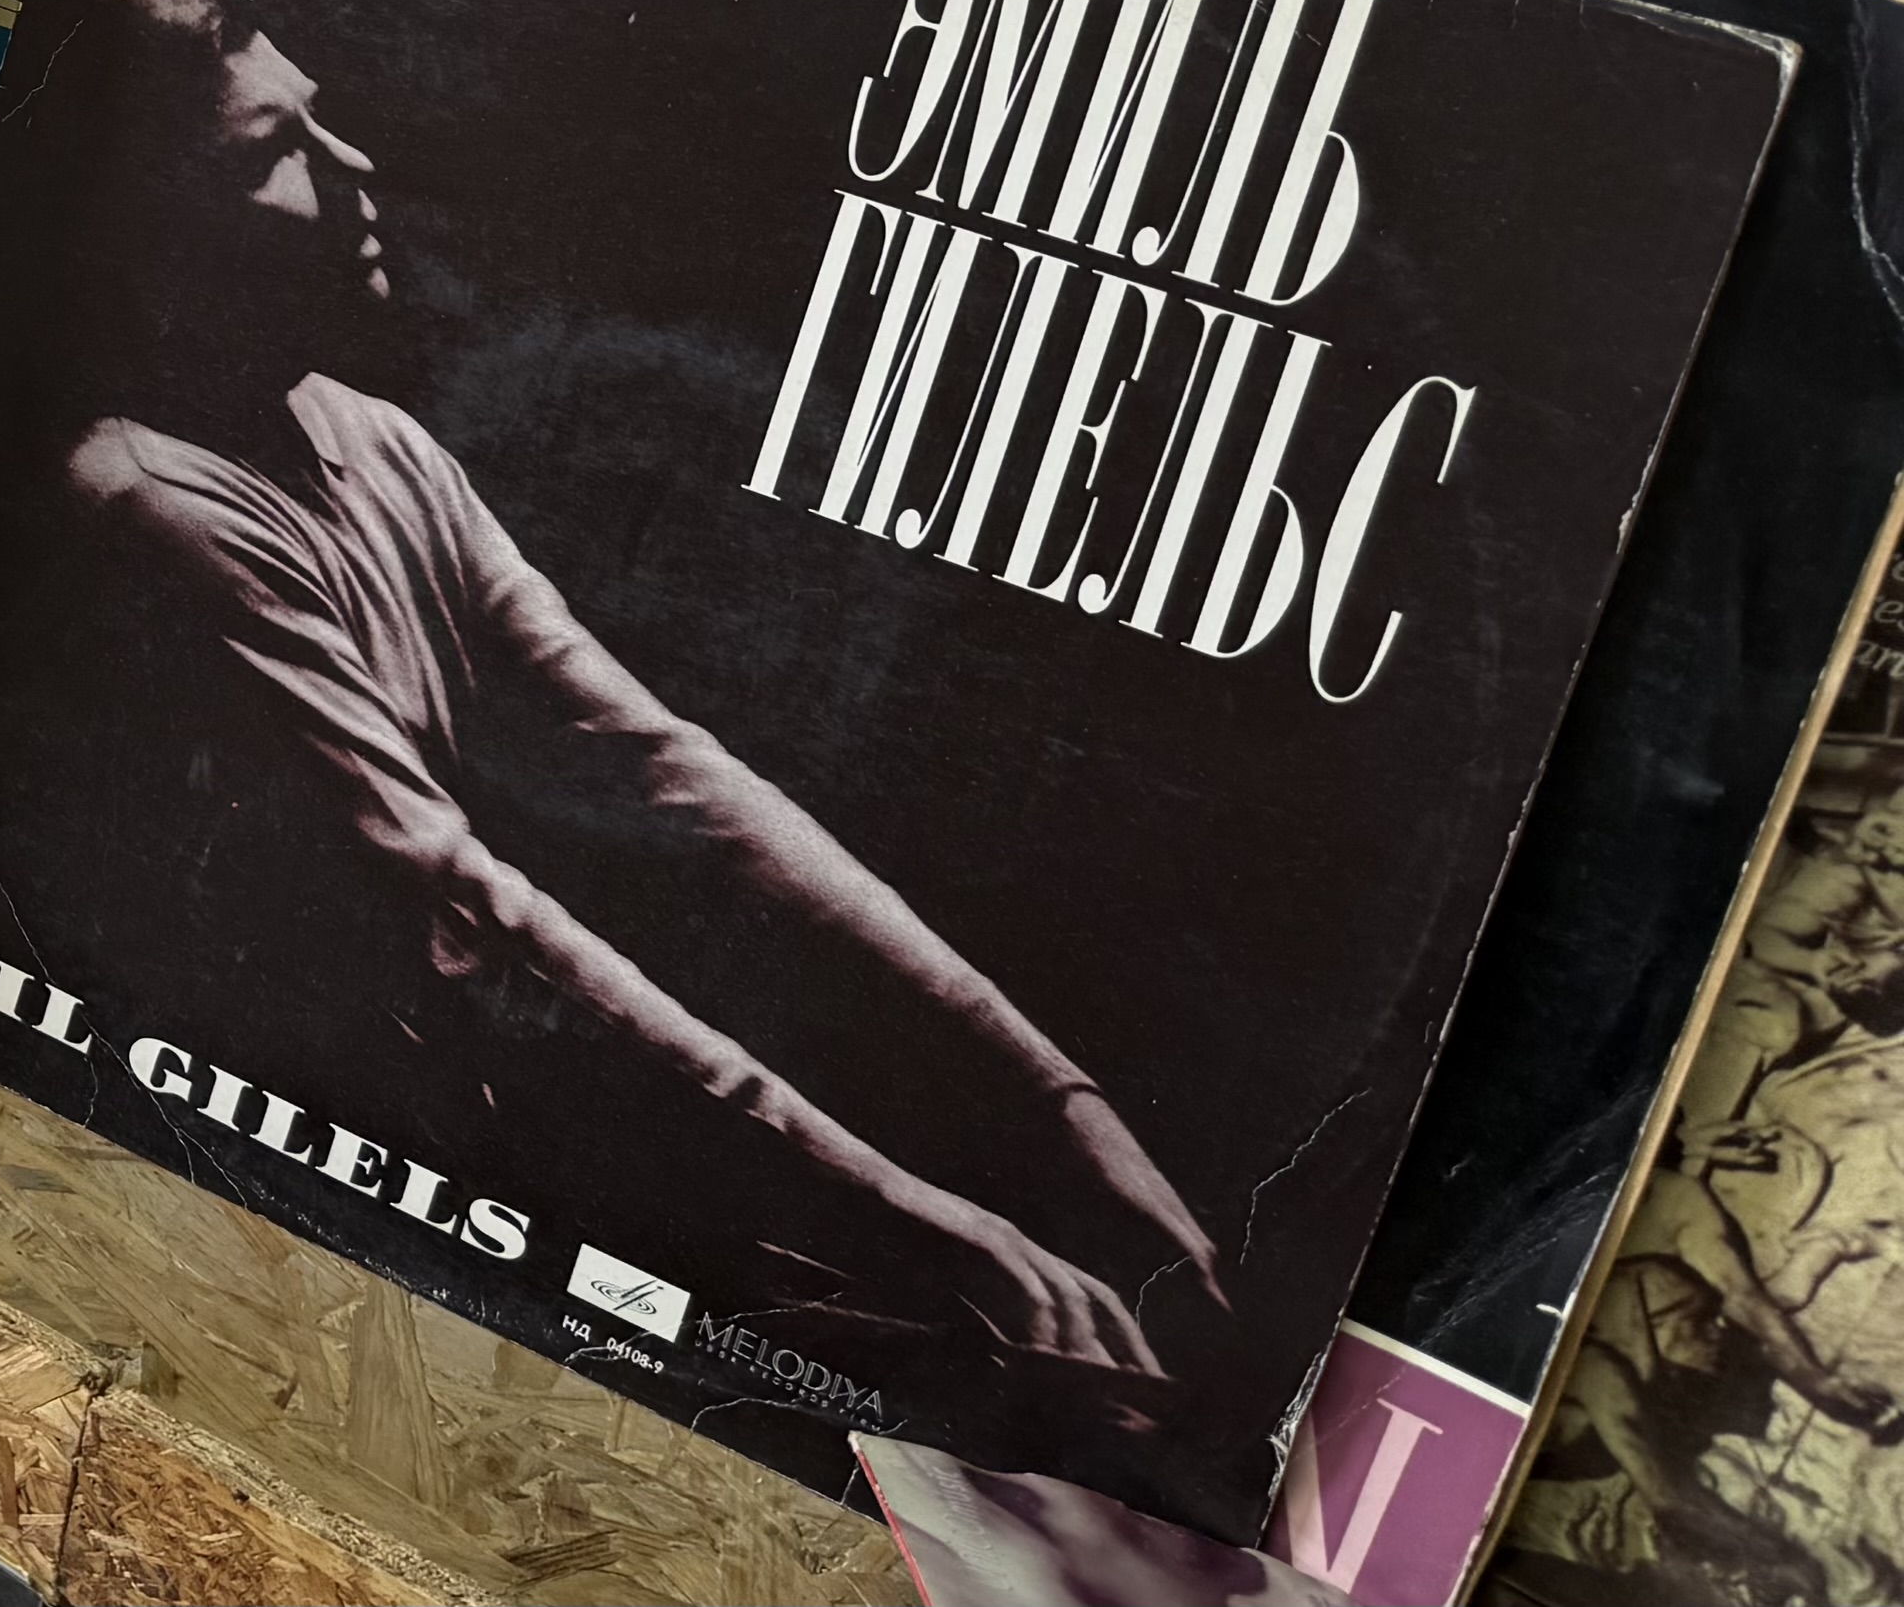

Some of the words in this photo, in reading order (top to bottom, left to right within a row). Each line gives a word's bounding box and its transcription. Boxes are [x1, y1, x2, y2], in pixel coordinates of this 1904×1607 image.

[739, 188, 1479, 706] ГИЛЕЛЬС
[128, 1035, 533, 1264] GILELS
[696, 1310, 885, 1422] MELODIYA
